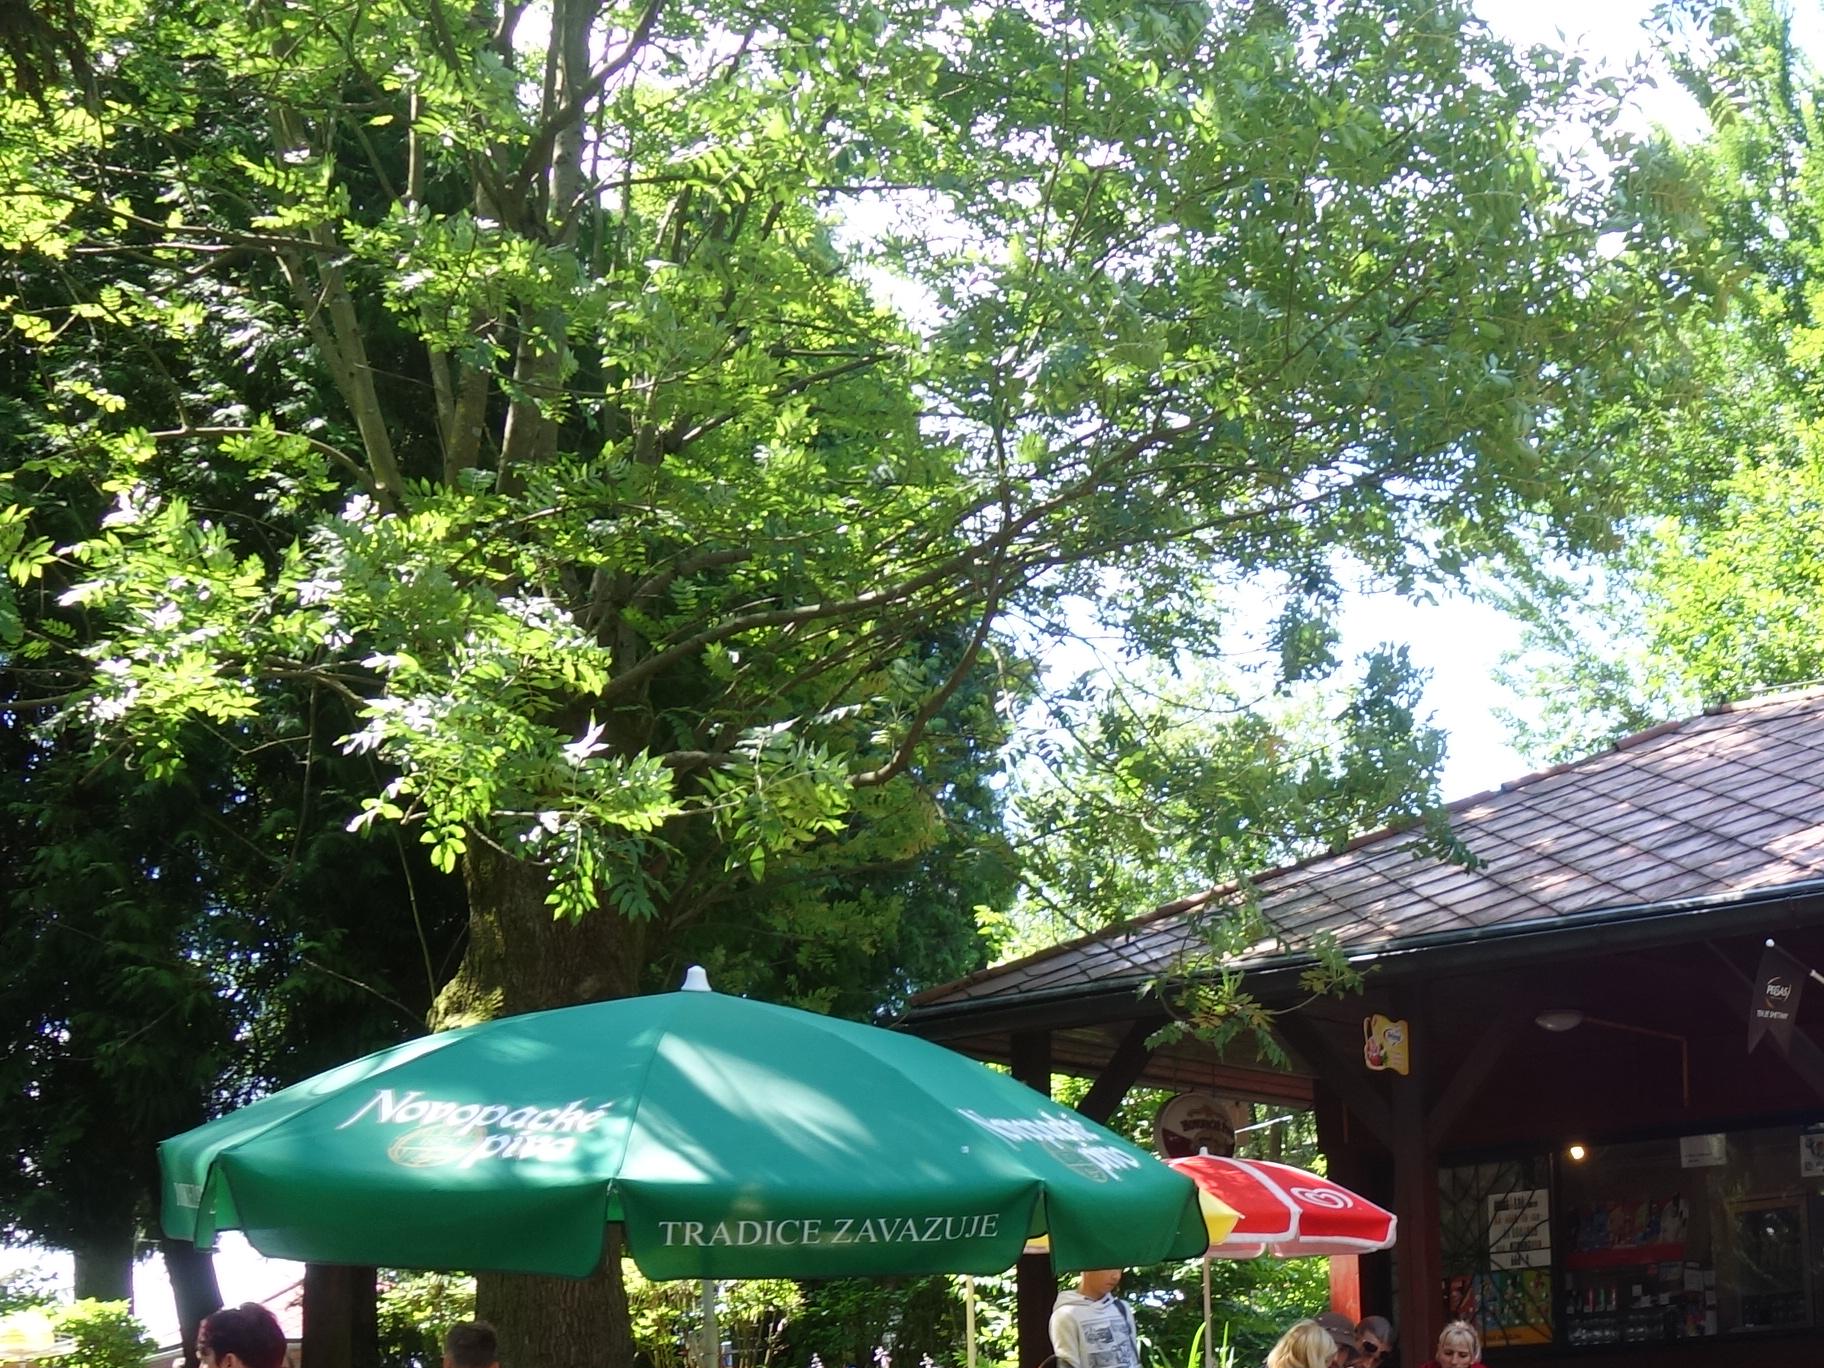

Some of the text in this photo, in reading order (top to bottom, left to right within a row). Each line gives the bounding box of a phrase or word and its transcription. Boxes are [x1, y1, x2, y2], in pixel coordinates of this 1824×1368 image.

[335, 1089, 615, 1137] Novopacké
[658, 1214, 999, 1246] TRADICE ZAVAZUJE
